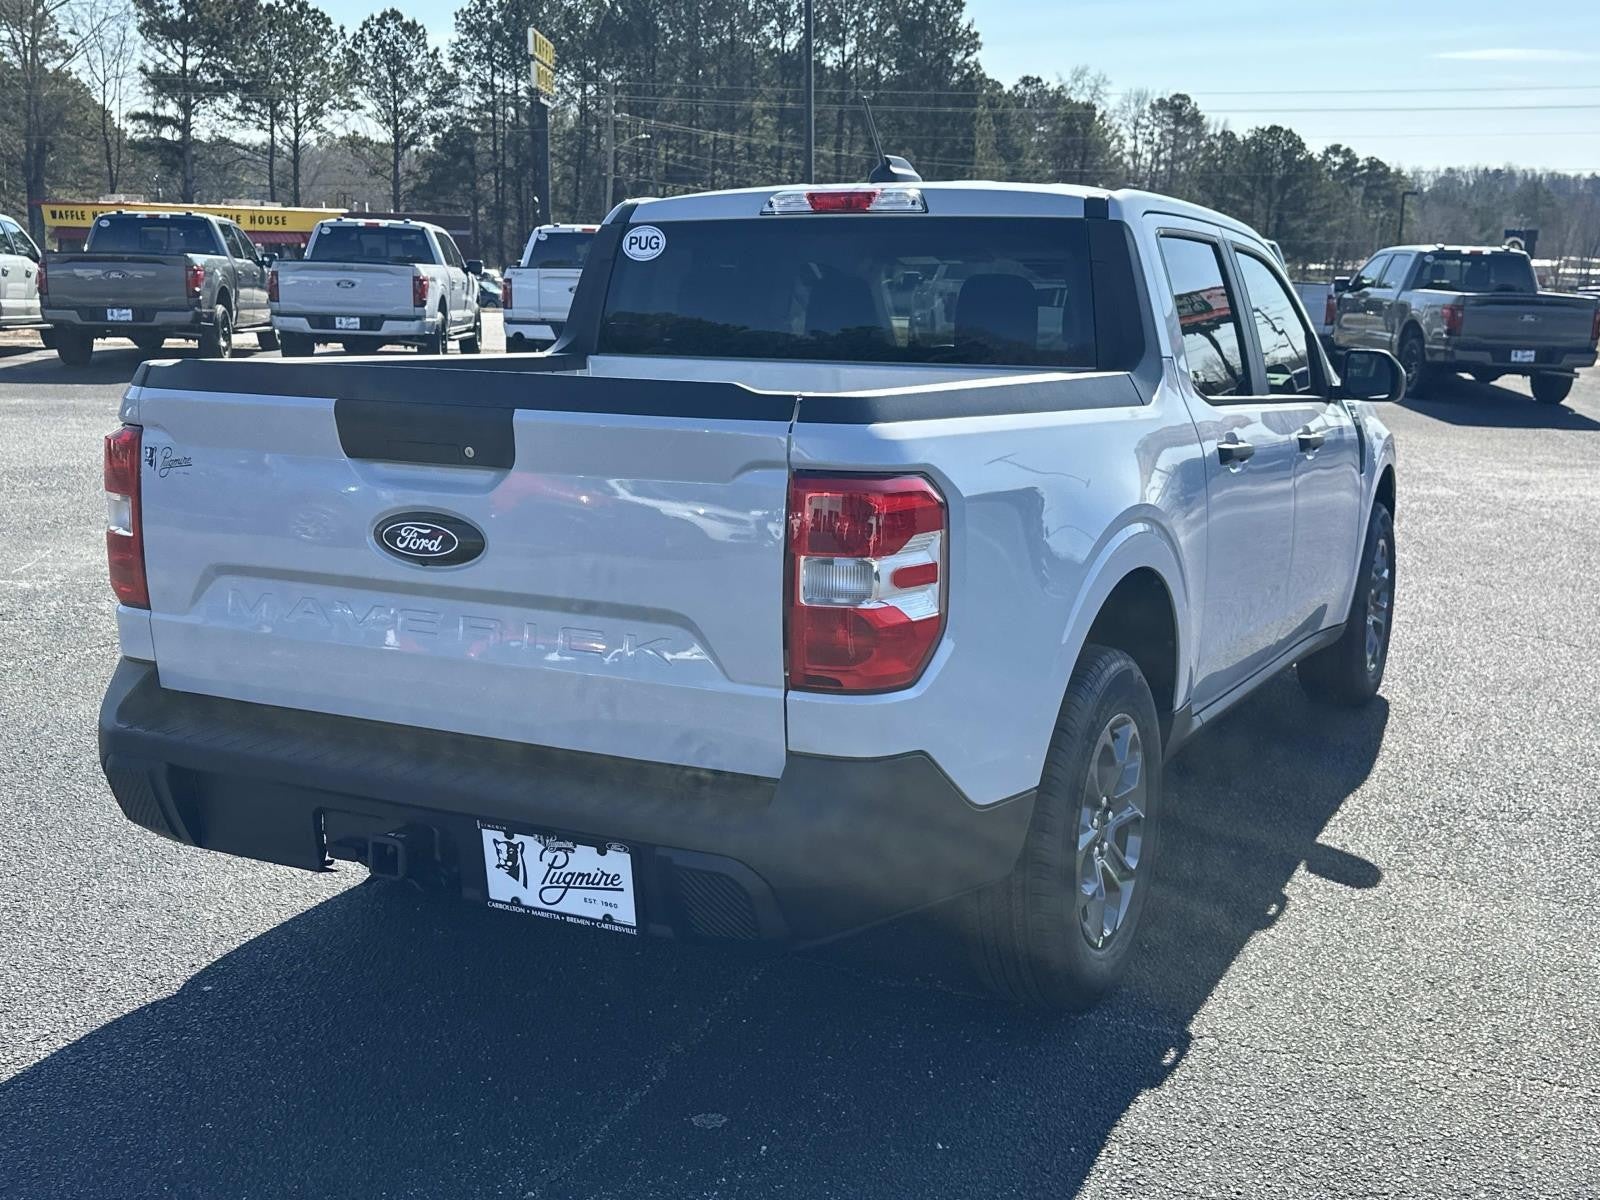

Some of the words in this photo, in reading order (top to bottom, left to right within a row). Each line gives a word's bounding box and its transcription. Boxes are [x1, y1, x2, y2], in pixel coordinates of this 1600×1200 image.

[50, 210, 86, 220] WAFFLE
[249, 215, 288, 226] HOUSE
[628, 235, 660, 251] PUG
[396, 526, 443, 552] Ford
[227, 587, 673, 666] MAVERICK
[538, 847, 625, 906] Pugmire
[601, 900, 618, 909] 1960
[487, 901, 526, 914] CARROLLTON
[531, 910, 560, 921] MARIETTA
[566, 916, 591, 926] BREMEN
[596, 922, 638, 936] CARTERSVILLE
